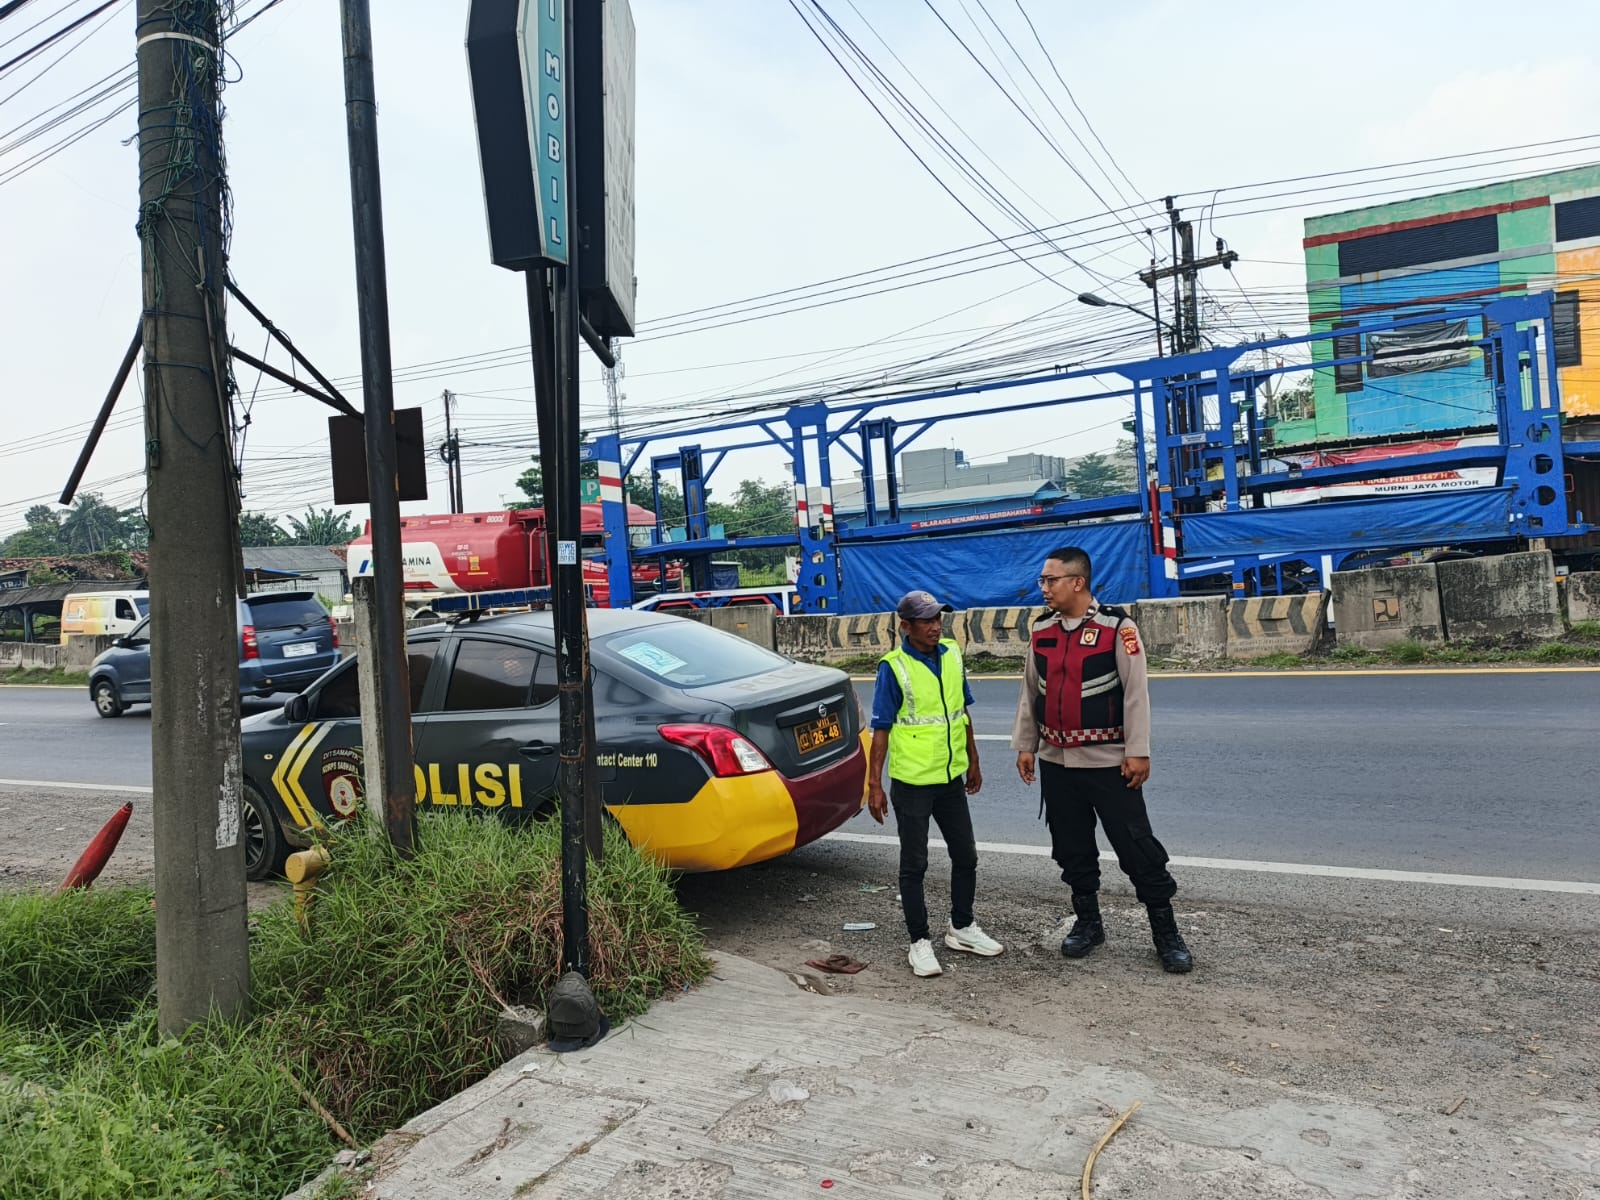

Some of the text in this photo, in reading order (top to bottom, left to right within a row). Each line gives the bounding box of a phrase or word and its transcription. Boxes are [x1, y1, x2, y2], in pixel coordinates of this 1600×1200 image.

[545, 48, 561, 245] MOBIL
[1374, 480, 1480, 493] MURNI JAYA MOTOR
[401, 556, 432, 567] AMINA
[596, 752, 659, 768] ntact Center 110
[413, 763, 523, 808] LISI
